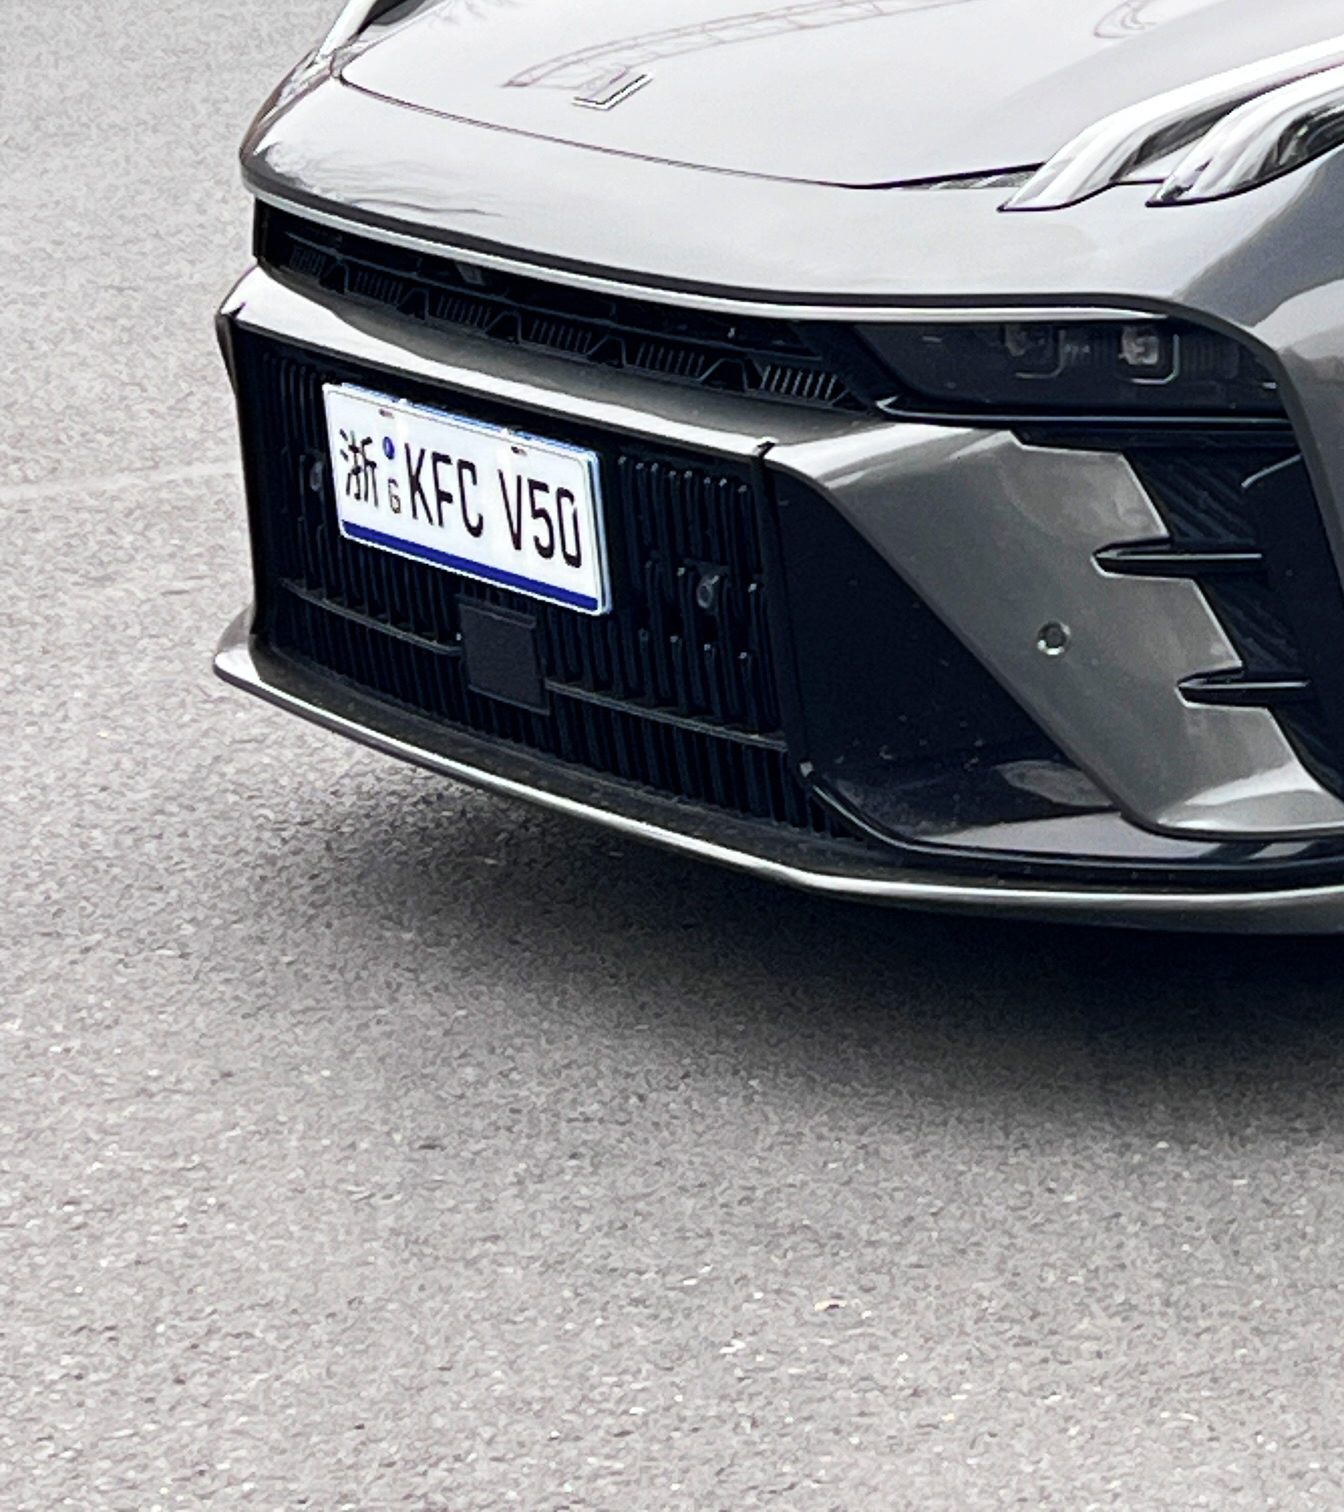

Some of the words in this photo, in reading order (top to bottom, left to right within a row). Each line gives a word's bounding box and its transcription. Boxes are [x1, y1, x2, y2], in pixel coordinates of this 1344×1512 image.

[339, 429, 379, 508] 浙
[387, 477, 402, 515] G
[404, 442, 485, 539] KFC
[498, 468, 583, 569] V50
